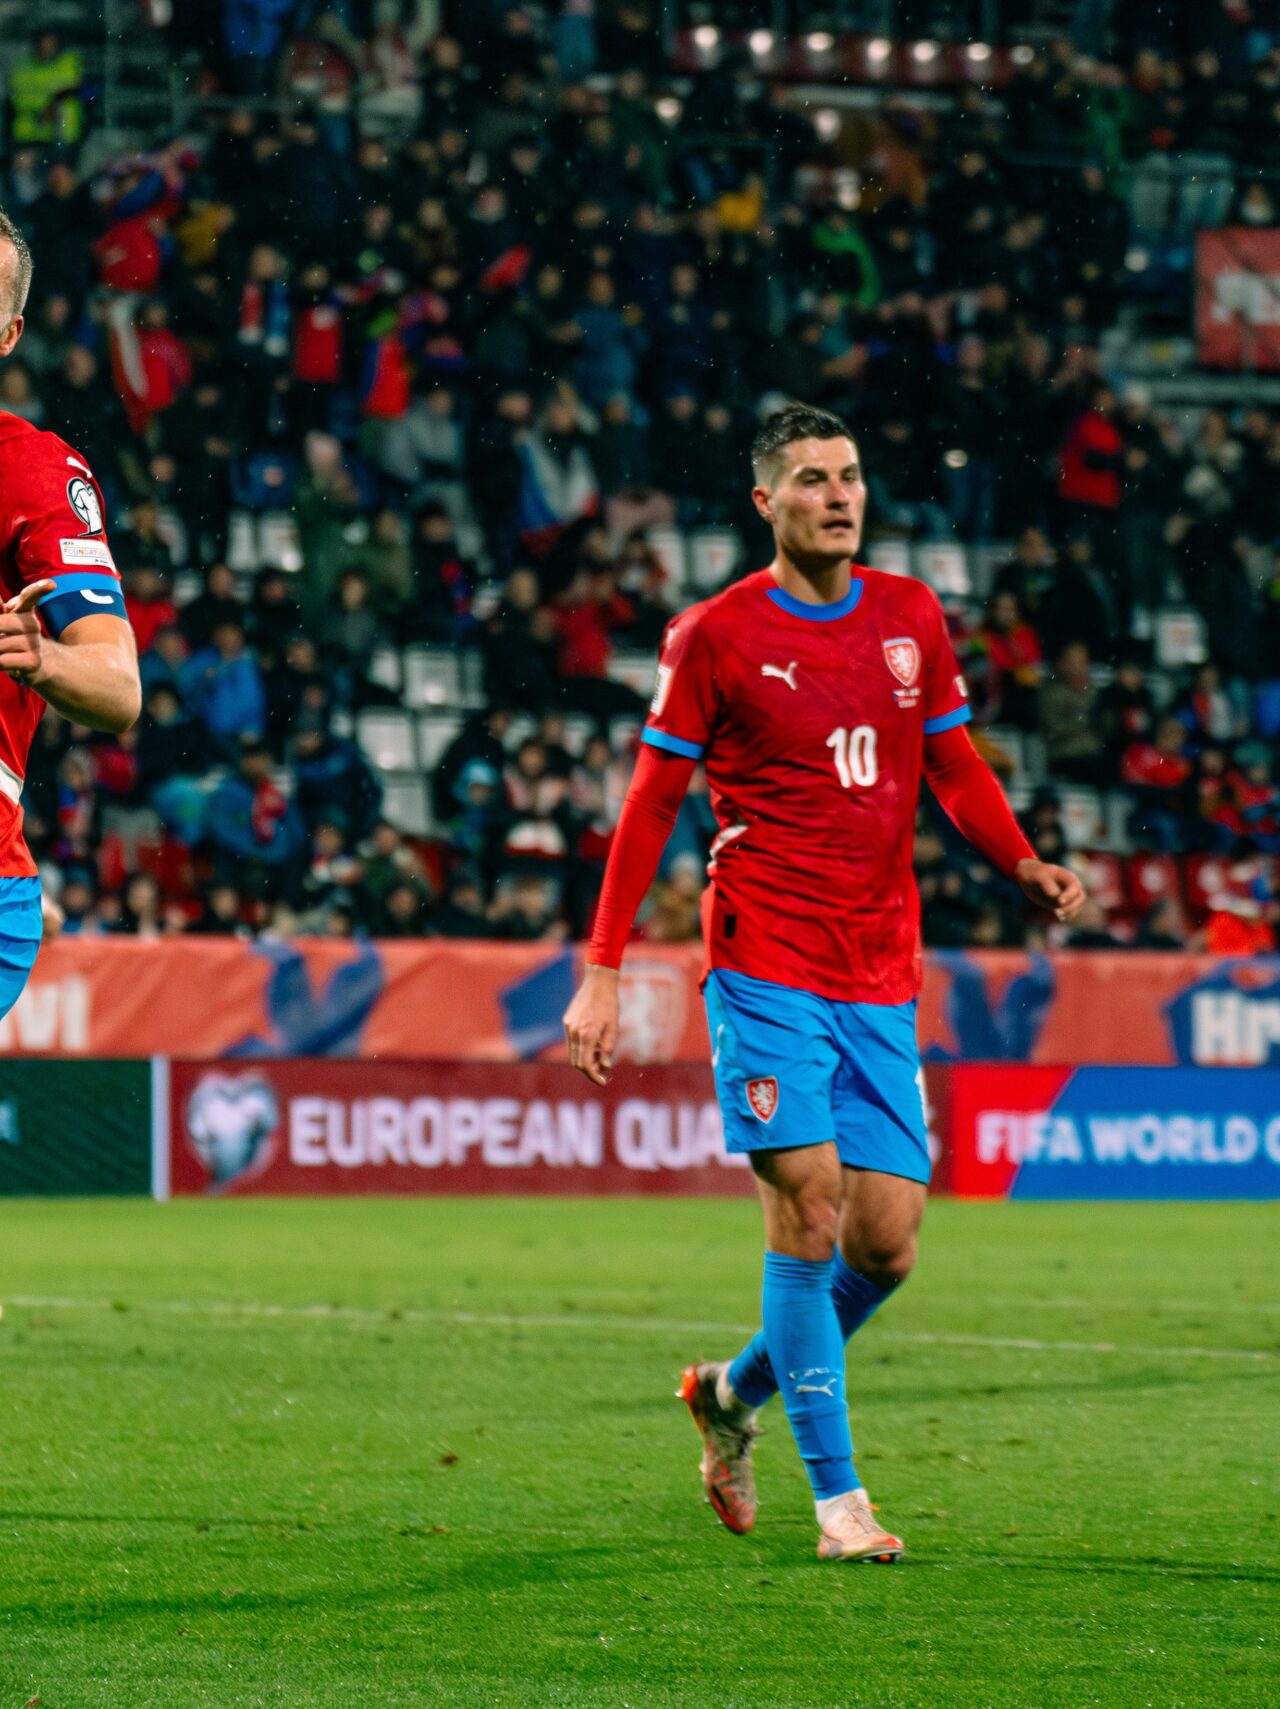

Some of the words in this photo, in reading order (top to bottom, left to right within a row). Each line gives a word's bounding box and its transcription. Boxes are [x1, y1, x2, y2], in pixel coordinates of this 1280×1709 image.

[825, 724, 878, 788] 10
[289, 1097, 603, 1168] EUROPEAN
[975, 1111, 1084, 1165] FIFA
[1087, 1113, 1259, 1165] WORLD
